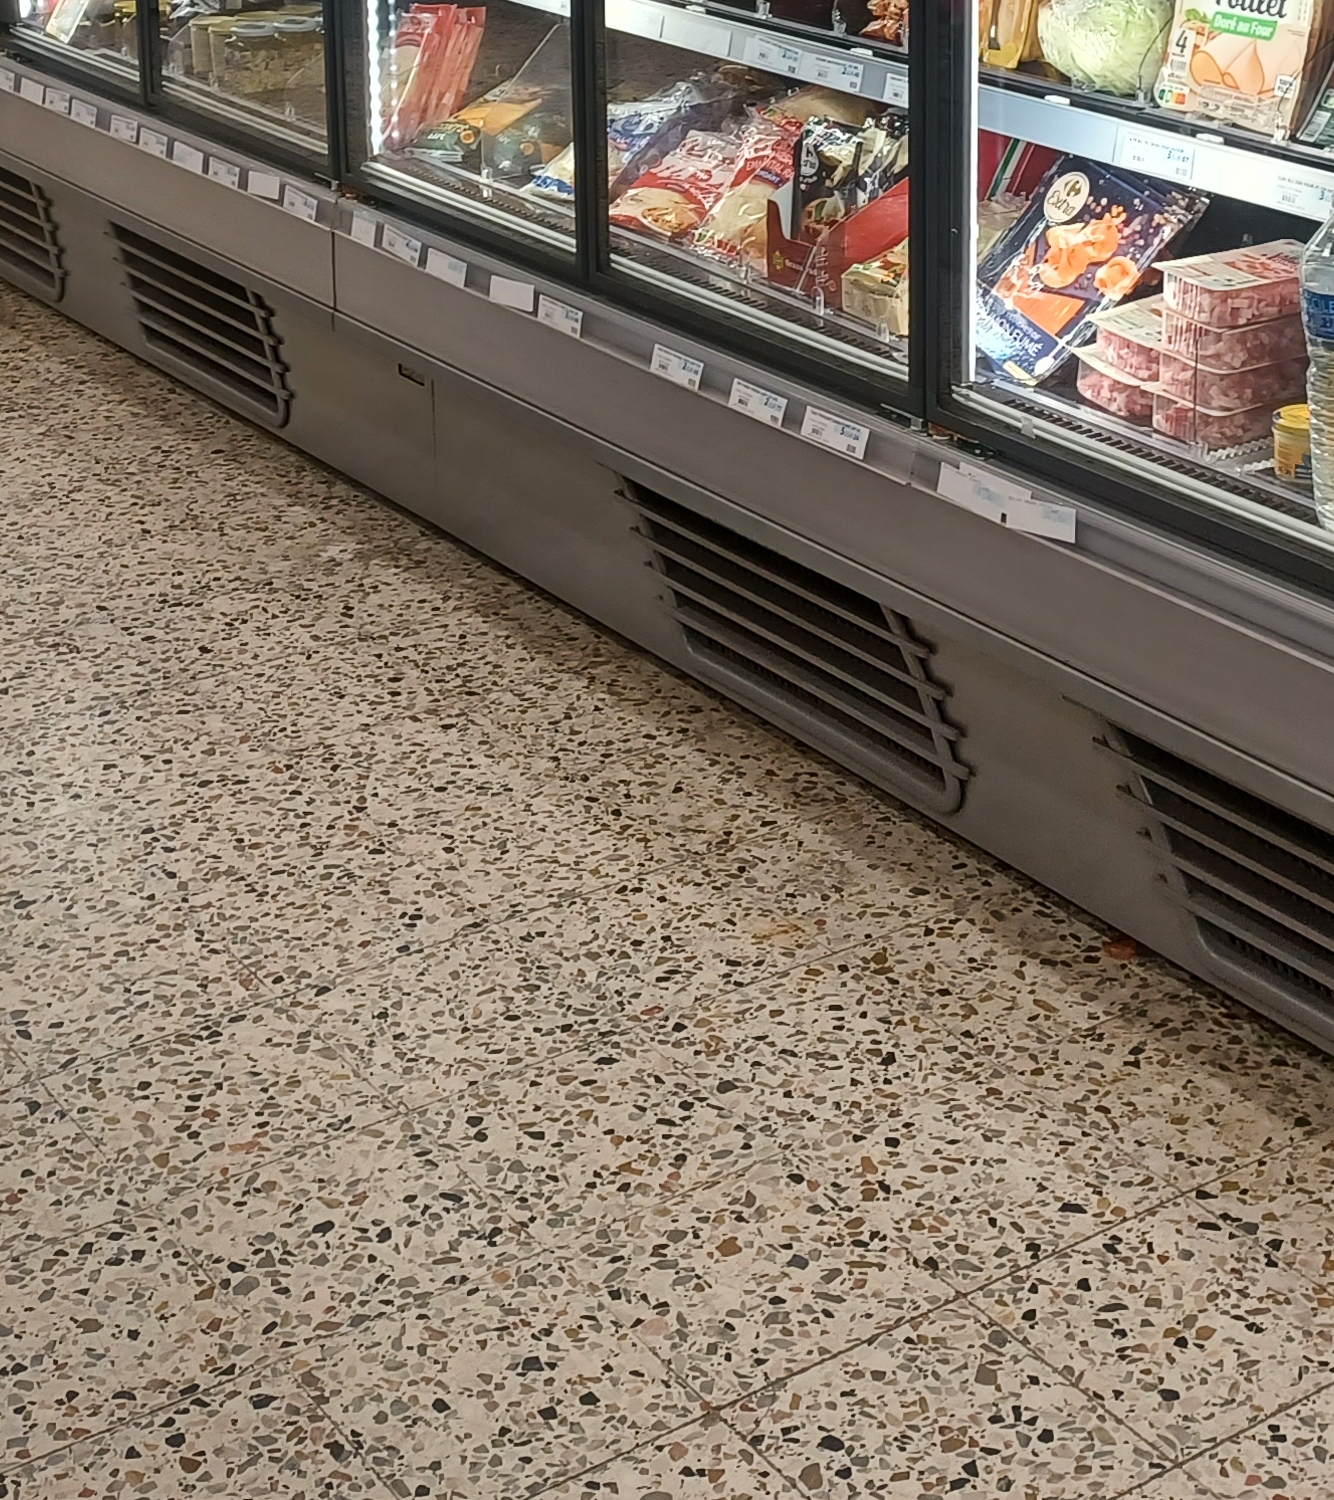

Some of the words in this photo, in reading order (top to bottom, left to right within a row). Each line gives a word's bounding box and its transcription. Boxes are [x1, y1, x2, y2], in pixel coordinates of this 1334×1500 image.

[1214, 13, 1237, 31] Doré
[1237, 21, 1249, 33] au
[1249, 21, 1274, 38] Four
[1175, 29, 1188, 54] 4
